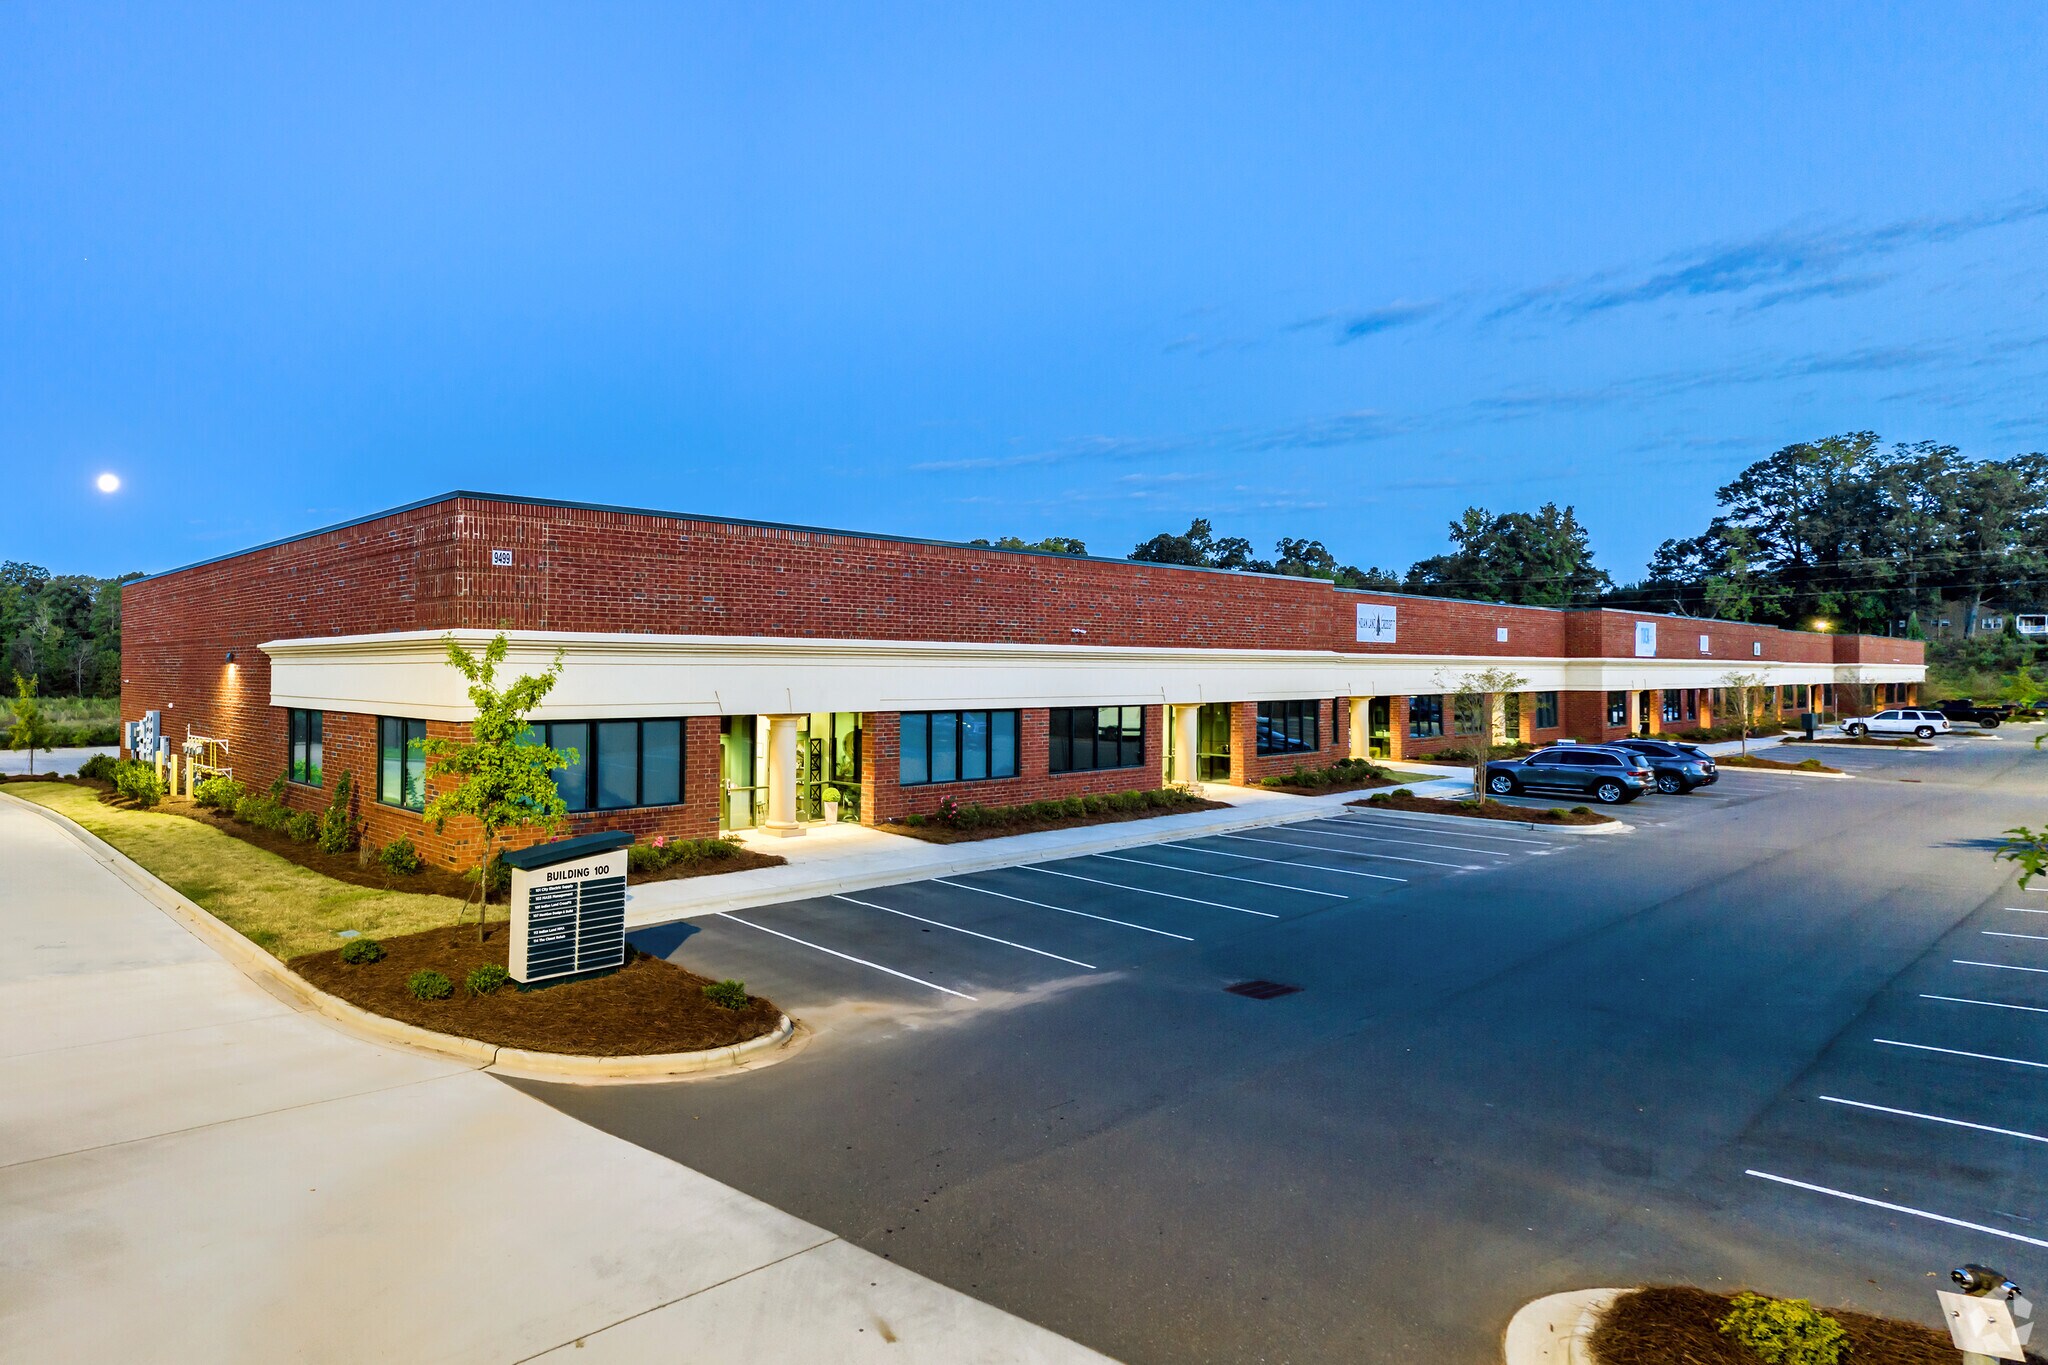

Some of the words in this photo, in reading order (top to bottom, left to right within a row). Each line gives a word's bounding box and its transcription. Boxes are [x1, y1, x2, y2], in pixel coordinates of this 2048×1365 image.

[494, 552, 511, 564] 9499
[547, 868, 589, 881] BUILDING
[595, 865, 610, 875] 100
